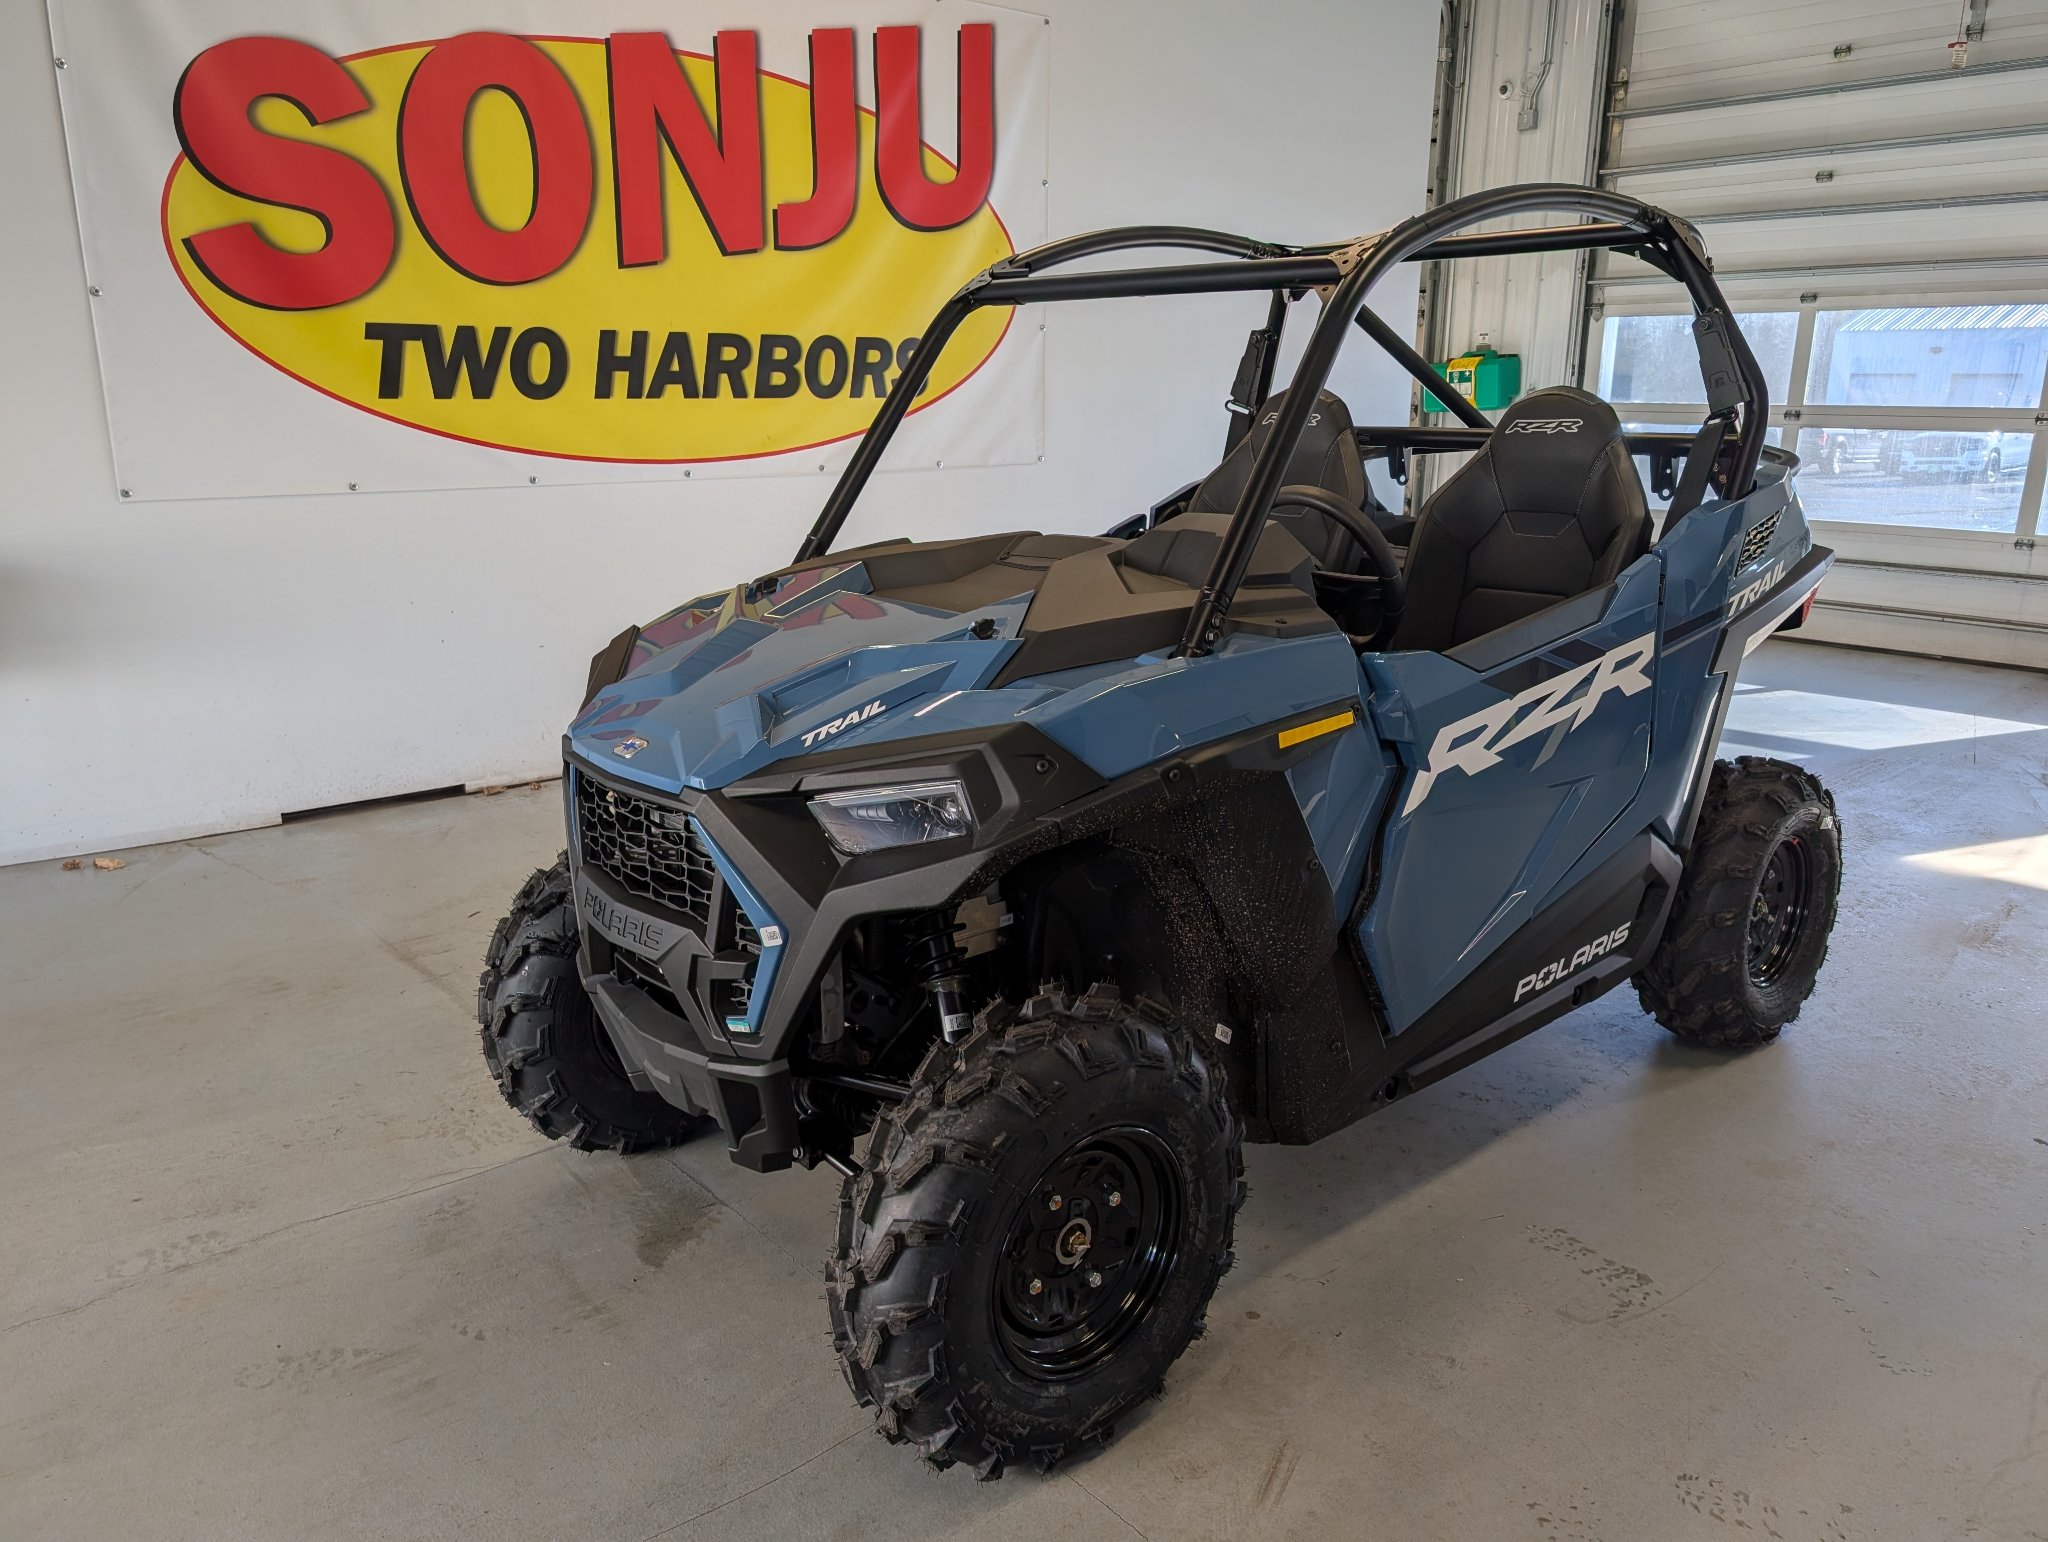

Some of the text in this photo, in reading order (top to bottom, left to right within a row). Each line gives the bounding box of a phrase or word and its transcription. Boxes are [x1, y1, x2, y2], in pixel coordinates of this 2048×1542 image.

[173, 22, 993, 311] SONJU
[364, 322, 568, 400] TWO
[1505, 418, 1584, 434] RZR
[1728, 559, 1786, 618] TRAIL
[800, 699, 887, 748] TRAIL
[1401, 631, 1656, 818] RZR
[583, 885, 665, 952] POLARIS
[1513, 920, 1632, 1003] POLARIS
